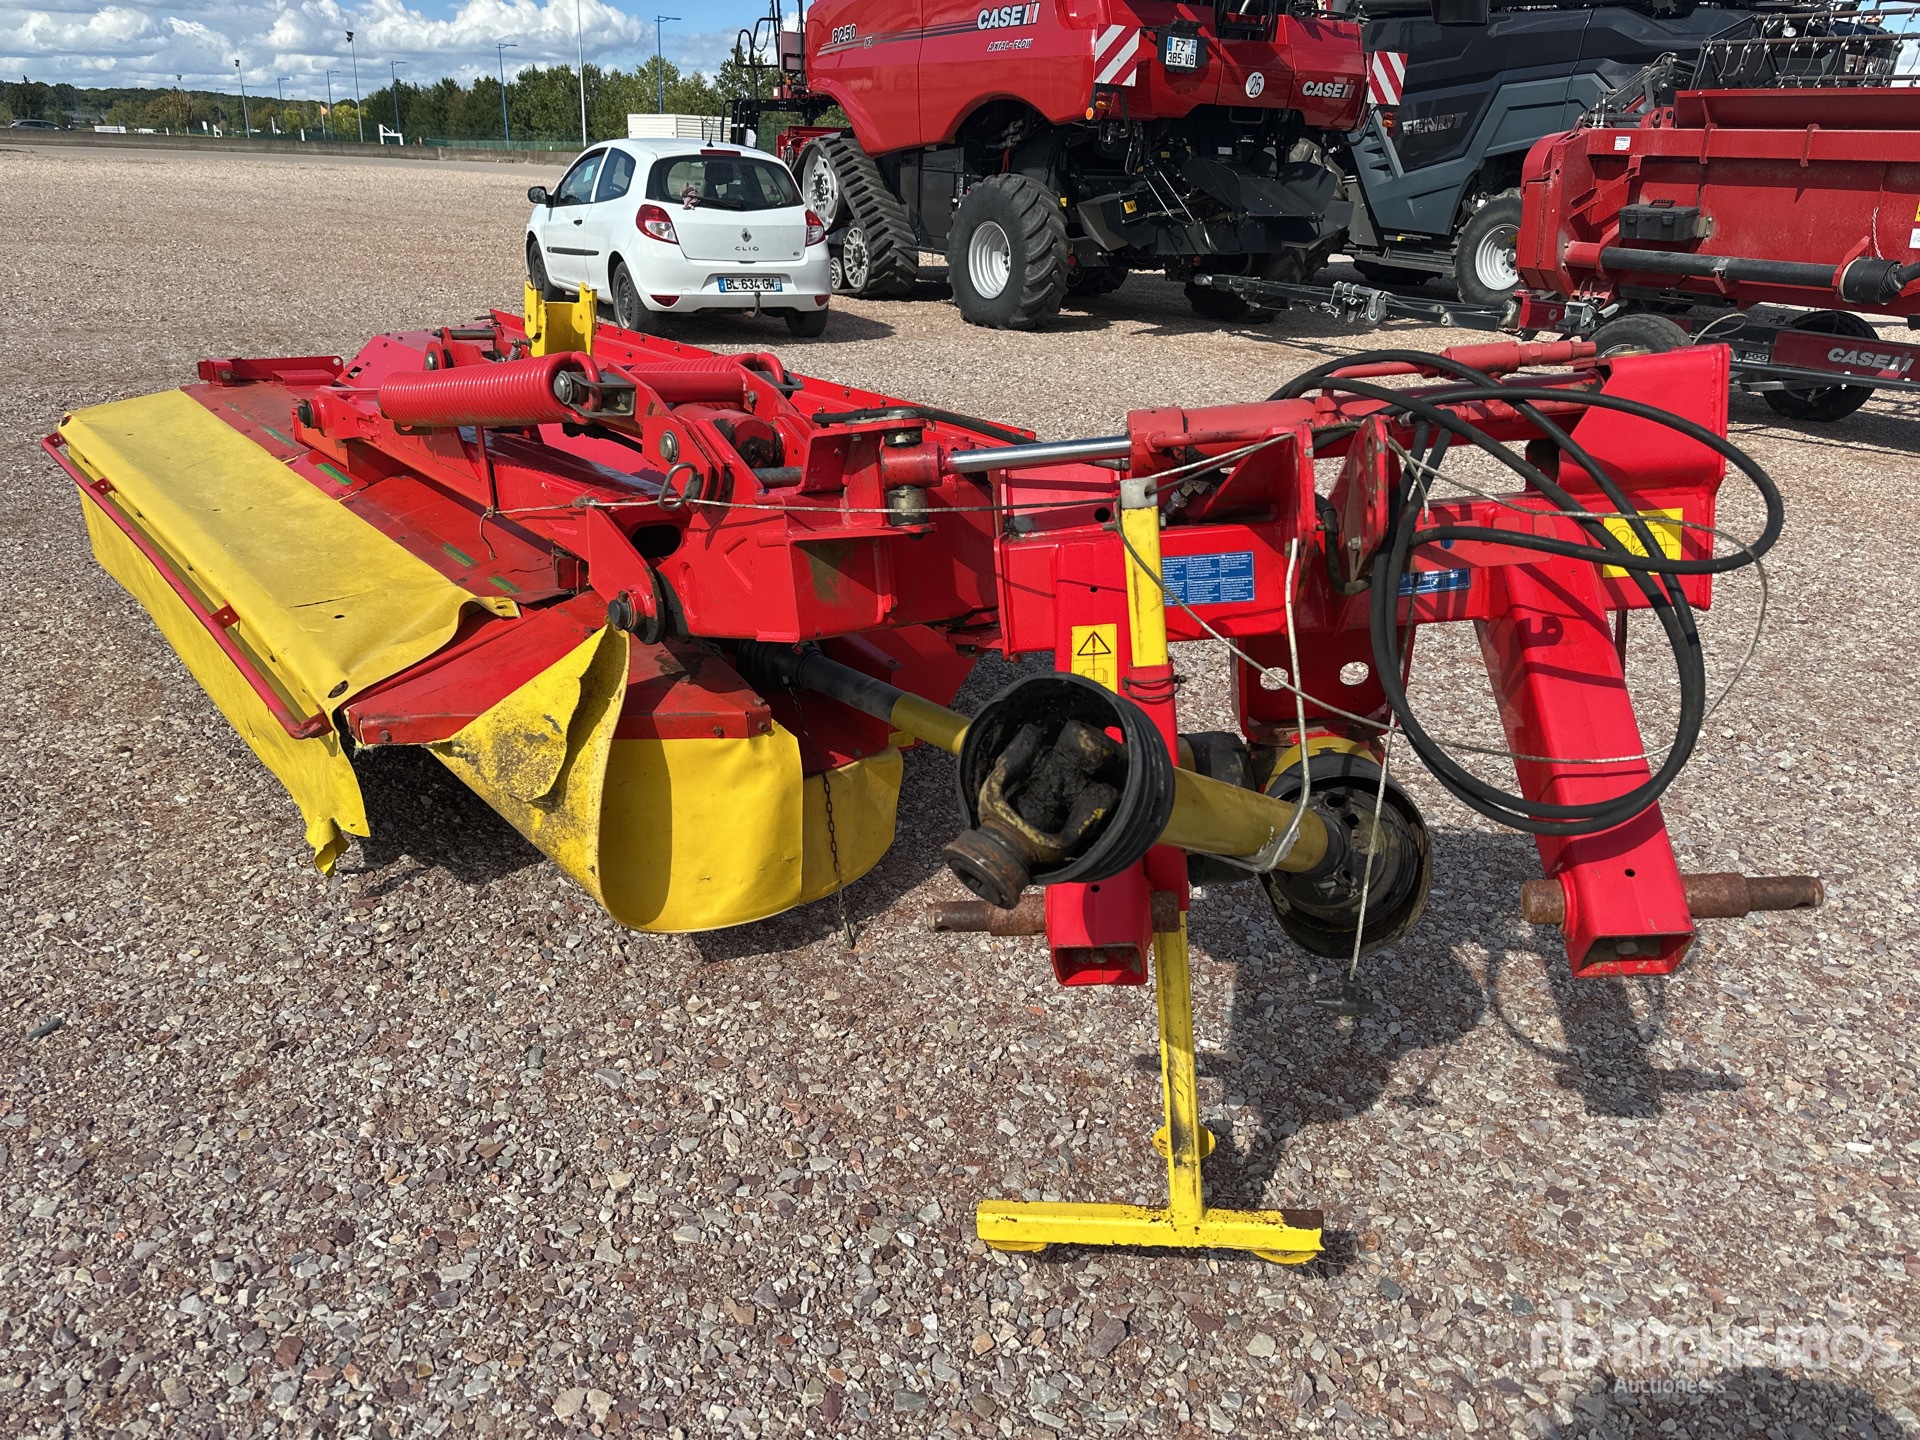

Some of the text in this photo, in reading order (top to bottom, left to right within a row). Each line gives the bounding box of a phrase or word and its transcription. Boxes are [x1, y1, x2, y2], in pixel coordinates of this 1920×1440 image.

[977, 5, 1023, 30] CASE
[832, 22, 857, 45] 8250
[987, 38, 1034, 52] AXIAL-FLOW
[1175, 39, 1186, 52] FZ
[1249, 75, 1262, 96] 25
[1302, 80, 1343, 98] CASE
[1402, 111, 1468, 136] FENDT
[1827, 347, 1888, 368] CASE
